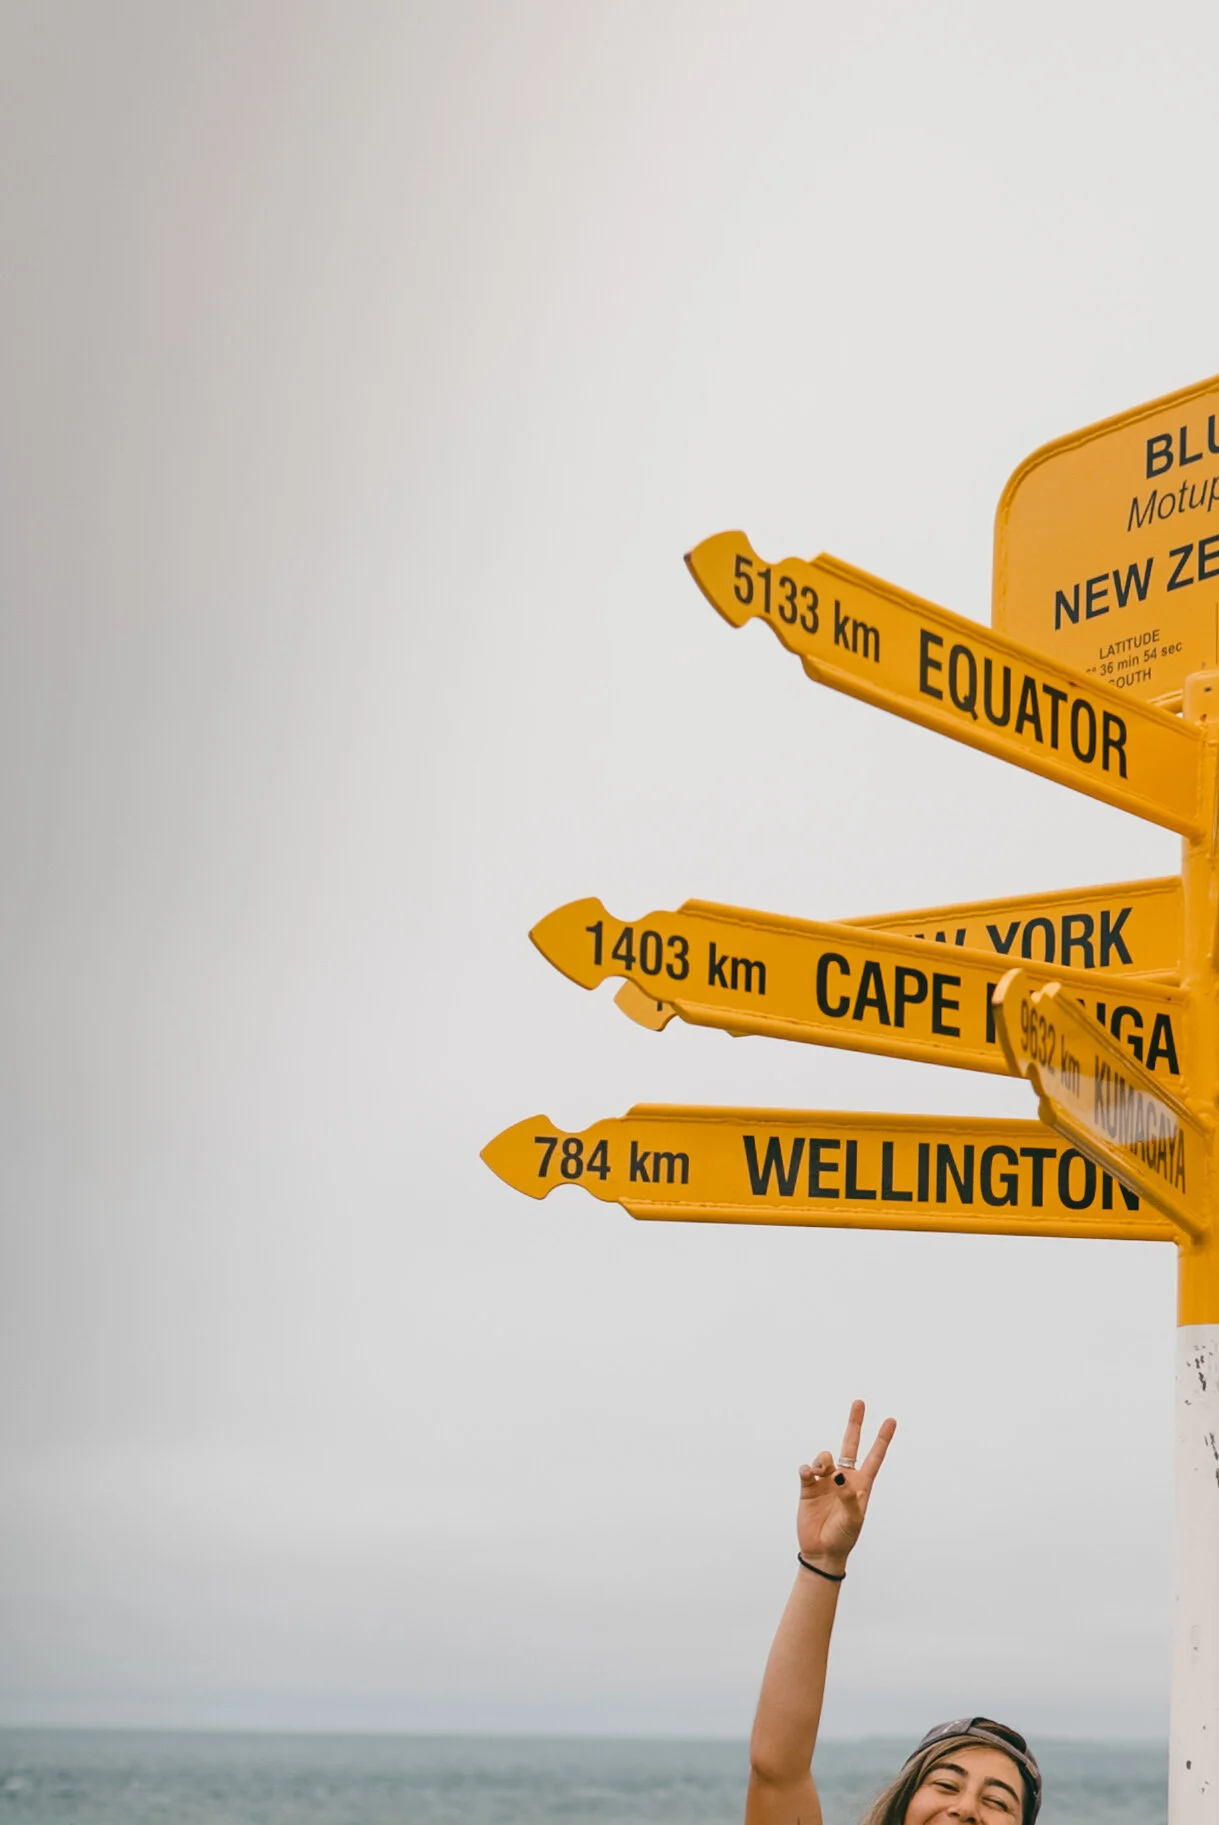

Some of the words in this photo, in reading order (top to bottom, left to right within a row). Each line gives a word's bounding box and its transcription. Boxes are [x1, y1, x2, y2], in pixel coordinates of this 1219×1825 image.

[1053, 557, 1154, 631] NEW
[733, 553, 820, 636] 5133
[833, 600, 880, 664] km
[919, 628, 1129, 781] EQUATOR
[1099, 629, 1161, 660] LATITUDE
[1100, 661, 1114, 677] 36
[1117, 655, 1140, 671] min
[1143, 647, 1157, 662] 54
[1161, 641, 1183, 657] sec
[1109, 667, 1152, 689] OUTH
[985, 907, 1134, 970] YORK
[585, 920, 691, 982] 1403
[708, 942, 768, 996] km
[816, 951, 962, 1039] CAPE
[1020, 998, 1056, 1076] 9632
[1060, 1033, 1081, 1100] km
[1094, 1054, 1187, 1196] KUMAGAYA
[534, 1136, 612, 1181] 784
[629, 1141, 690, 1185] km
[743, 1134, 1140, 1212] WELLINGTON
